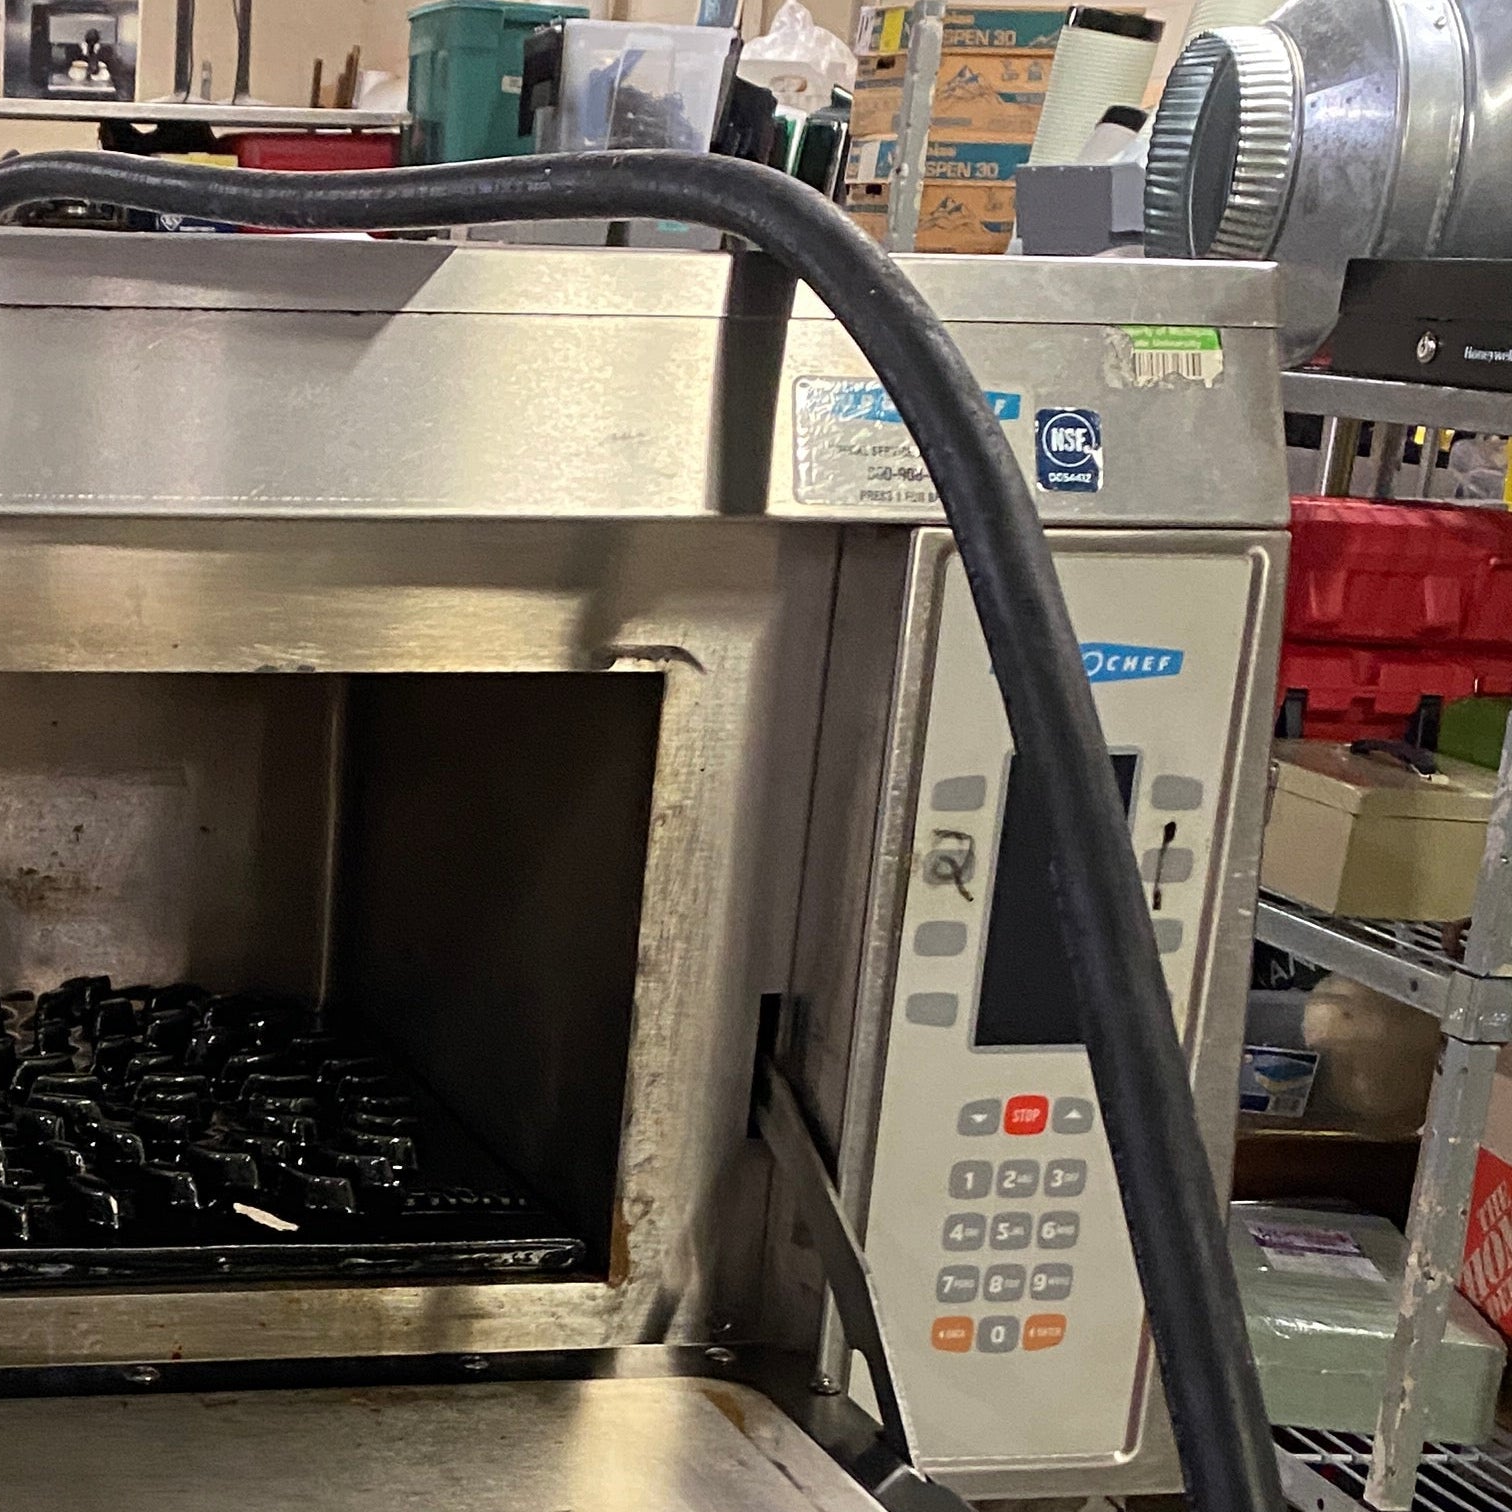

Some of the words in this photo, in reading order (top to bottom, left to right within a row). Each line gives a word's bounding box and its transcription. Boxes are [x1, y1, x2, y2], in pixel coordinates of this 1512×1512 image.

[942, 28, 989, 46] SPEN
[926, 161, 972, 178] SPEN
[1050, 427, 1088, 453] NSF
[1081, 650, 1173, 677] OCHEF
[1011, 1107, 1041, 1123] STOP
[964, 1171, 975, 1191] 1
[990, 1325, 1005, 1344] 0
